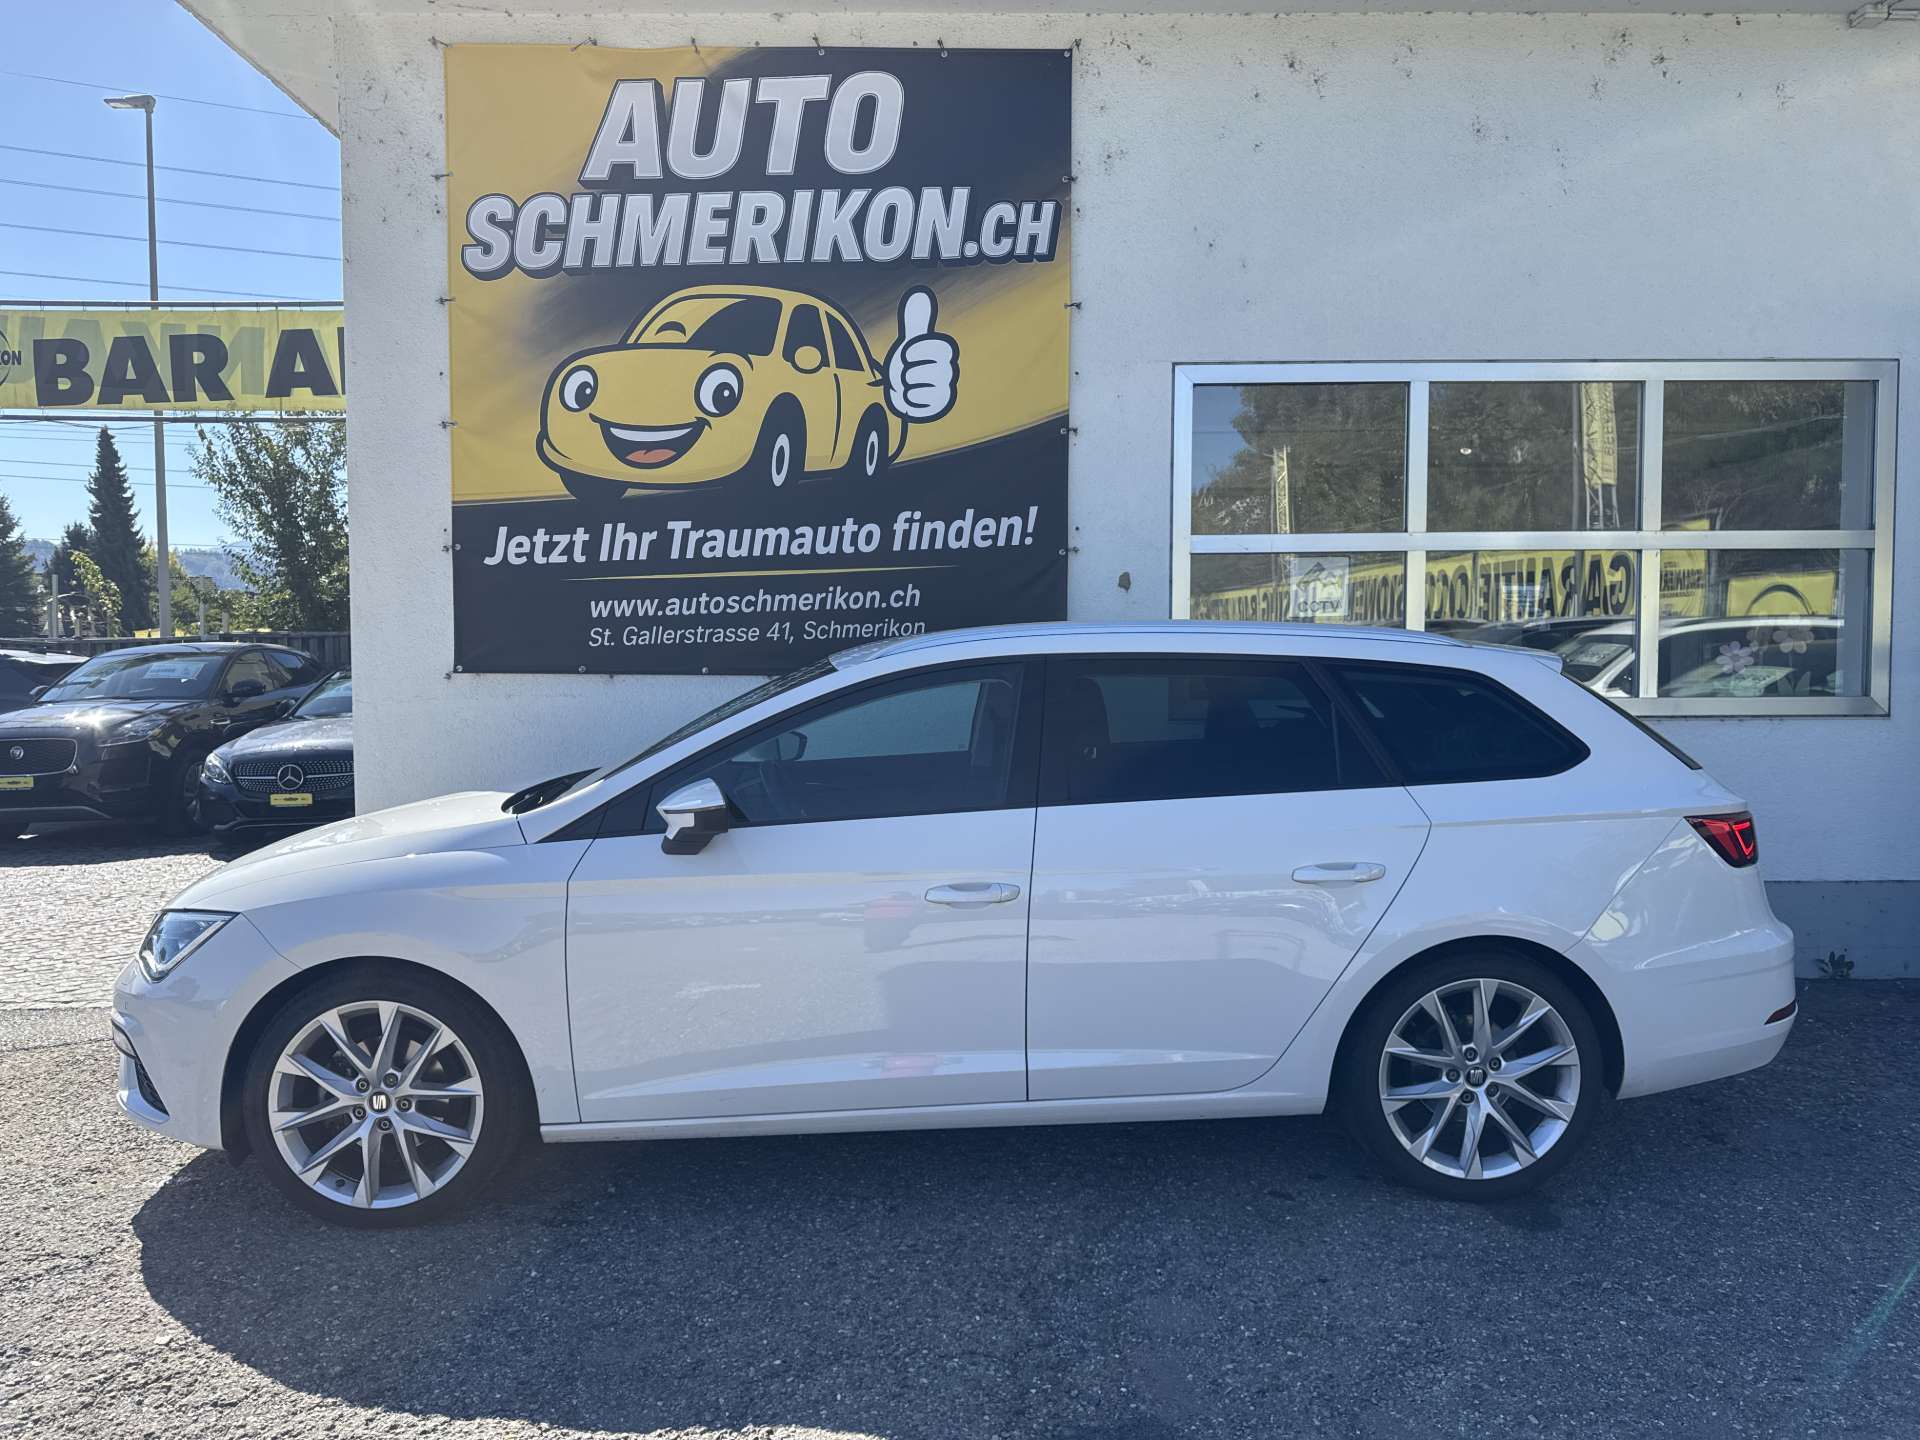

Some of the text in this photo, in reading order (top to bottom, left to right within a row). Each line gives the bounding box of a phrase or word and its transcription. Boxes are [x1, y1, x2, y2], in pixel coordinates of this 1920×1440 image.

[577, 69, 907, 190] AUTO
[460, 184, 1061, 280] SCHMERIKON.CH
[0, 350, 22, 366] ON
[33, 333, 235, 407] BAR
[483, 506, 1039, 568] Jetzt Ihr Traumauto finden!
[588, 618, 926, 647] St. Gallerstrasse 41, Schmerikon
[589, 585, 921, 619] www.autoschmerikon.ch
